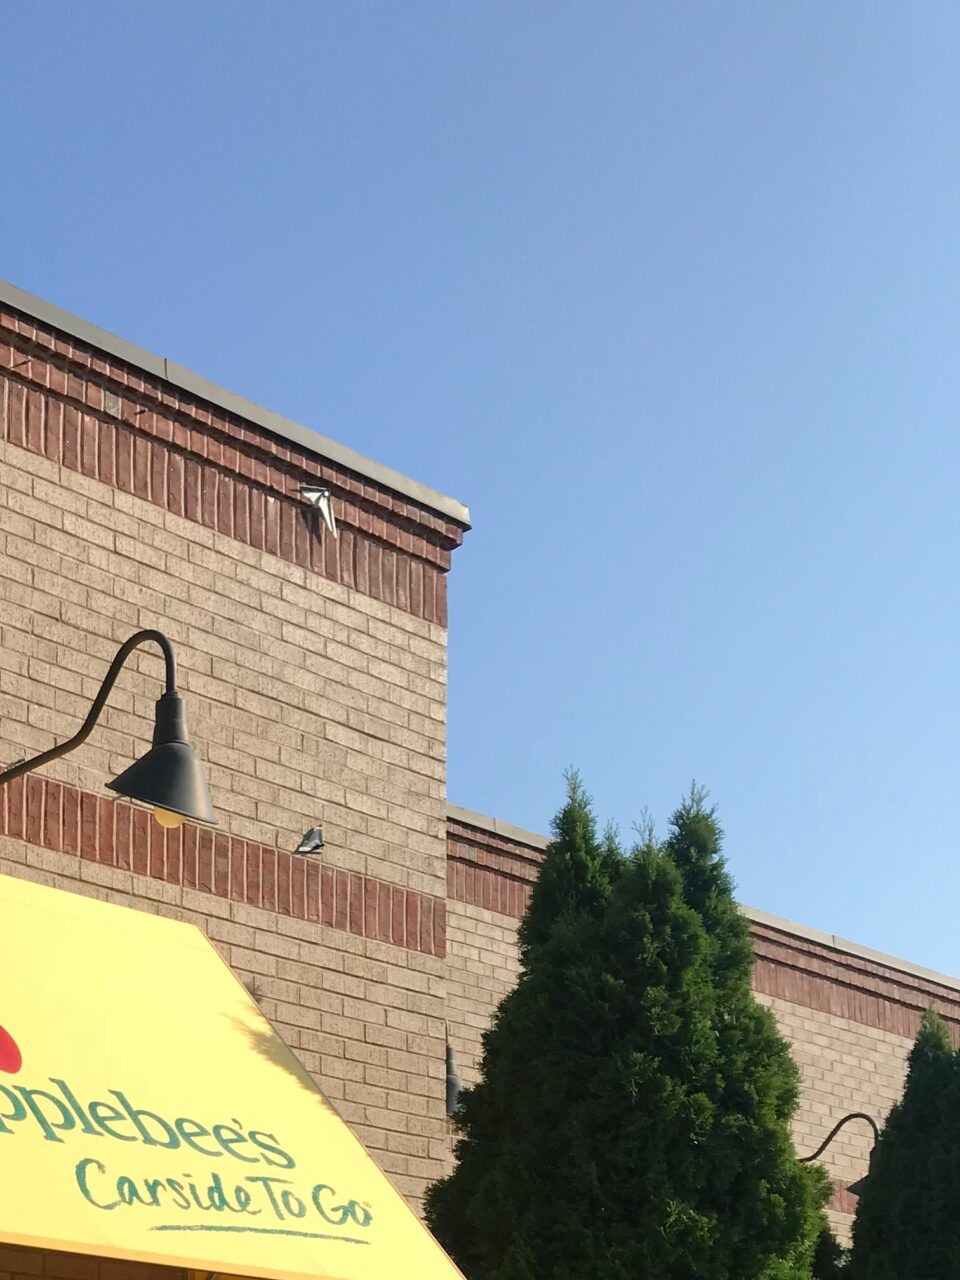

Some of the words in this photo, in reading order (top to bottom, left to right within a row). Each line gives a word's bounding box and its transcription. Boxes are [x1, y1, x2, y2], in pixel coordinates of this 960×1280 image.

[75, 1158, 262, 1215] Carside
[245, 1176, 307, 1220] To
[312, 1184, 373, 1227] Go
